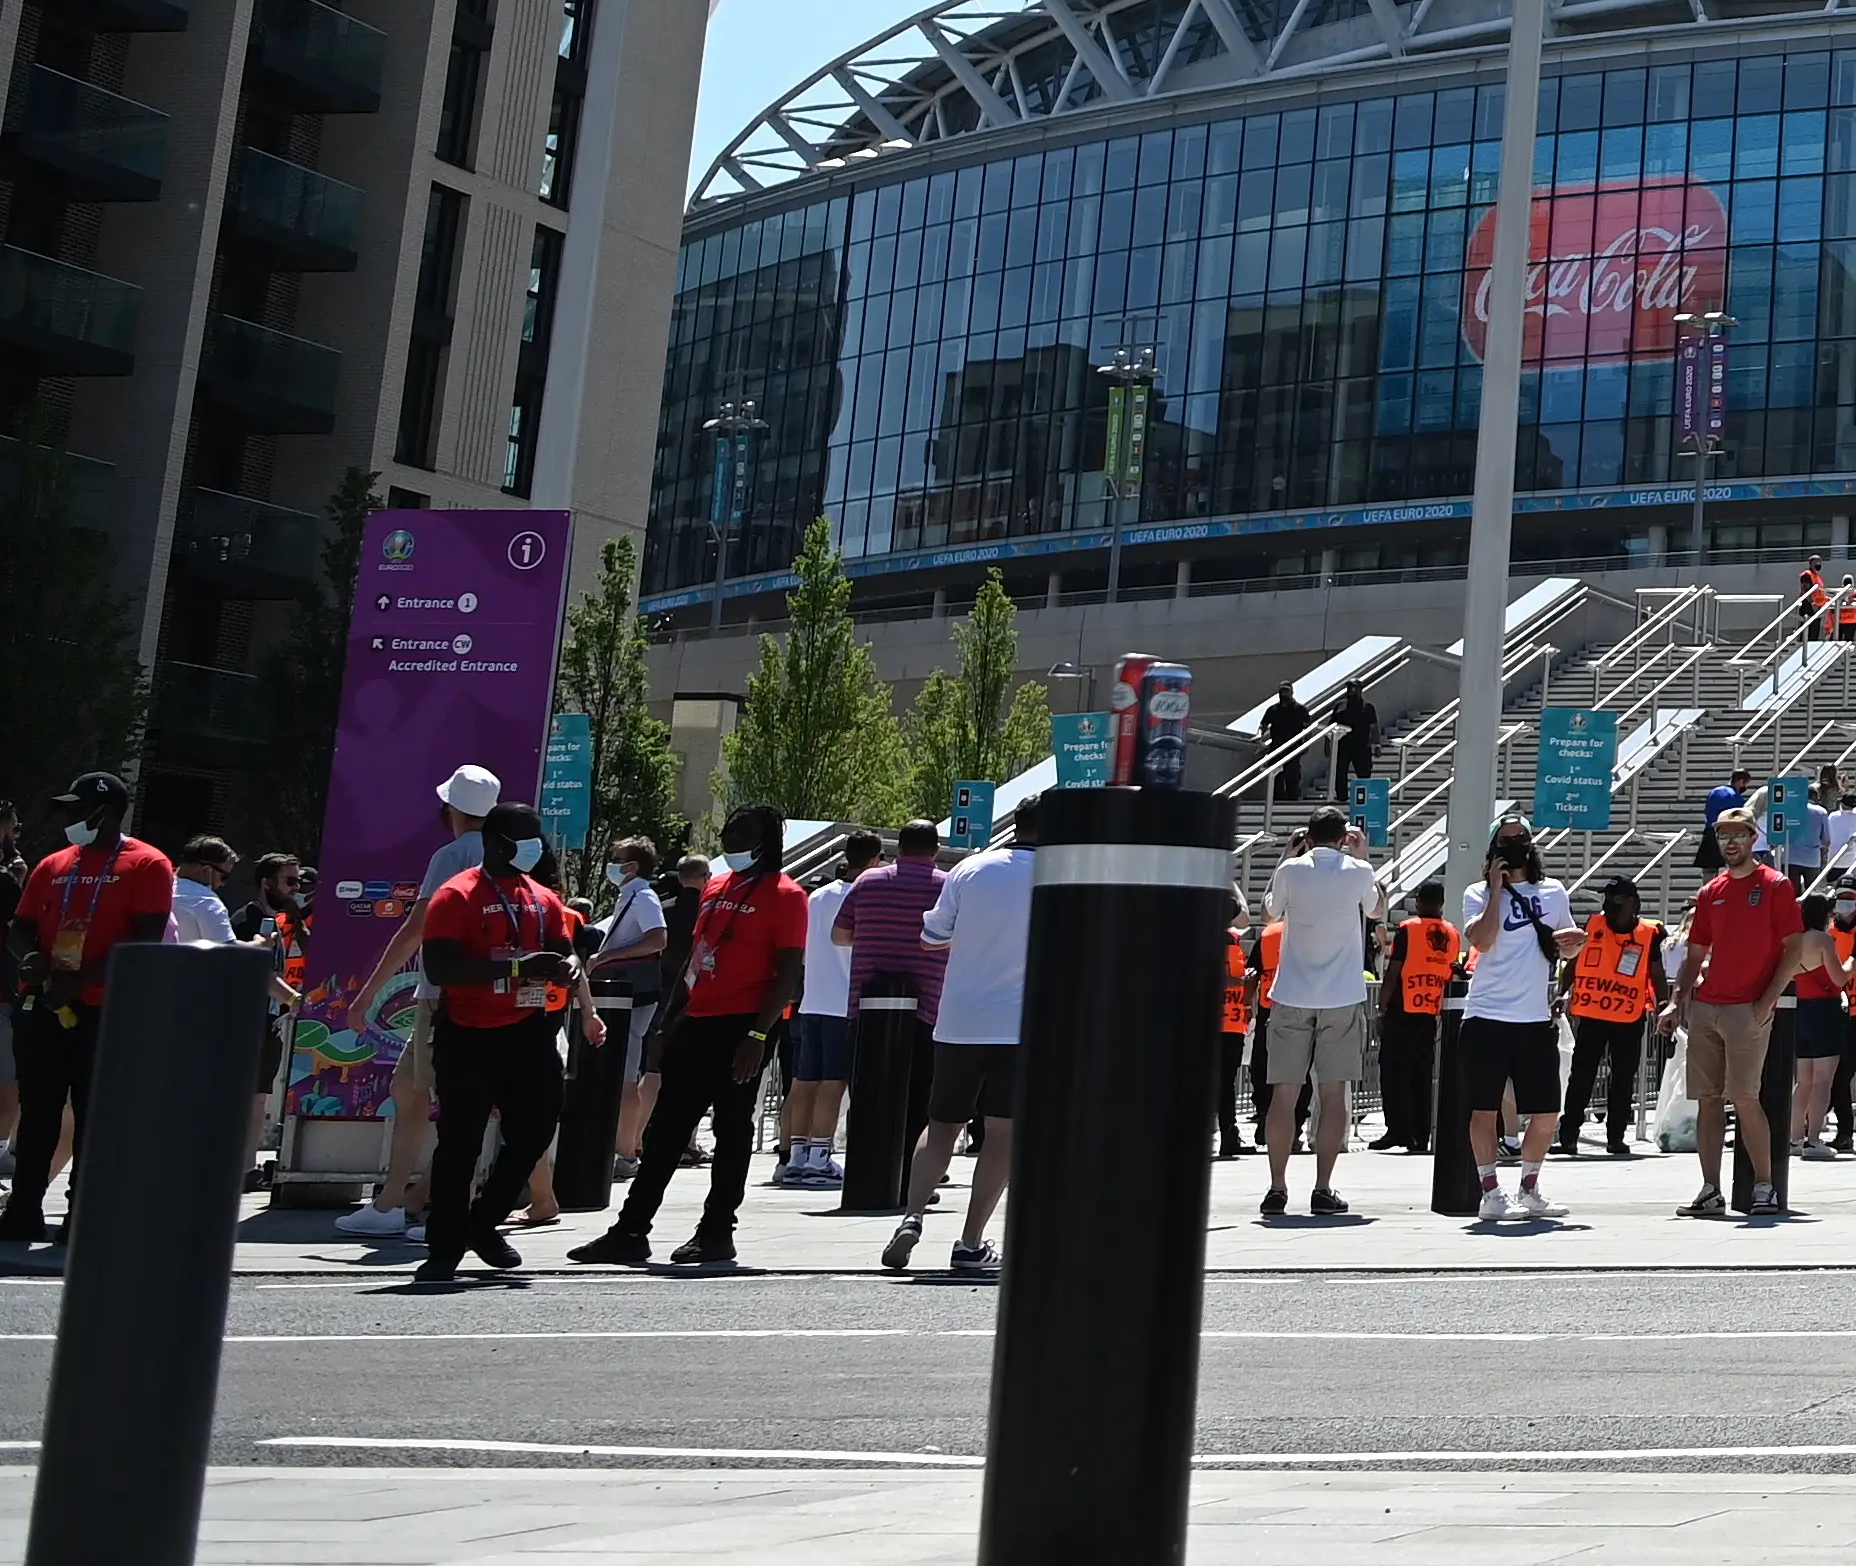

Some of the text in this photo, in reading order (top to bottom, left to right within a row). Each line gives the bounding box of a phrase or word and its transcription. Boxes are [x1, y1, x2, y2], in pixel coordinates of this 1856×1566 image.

[1630, 491, 1661, 504] UEFA
[1363, 504, 1454, 522] UEFA EURO 2020
[1130, 524, 1208, 543] UEFA EURO 2020
[397, 597, 454, 609] Entrance
[391, 639, 449, 650] Entrance
[389, 660, 518, 672] Accredited Entrance
[1063, 742, 1099, 752] Prepare
[1549, 737, 1604, 747] Prepare for
[547, 742, 581, 753] pare for
[546, 753, 573, 762] hecks:
[1558, 748, 1594, 758] checks:
[556, 781, 583, 789] status
[1064, 780, 1089, 788] Covid
[1544, 775, 1603, 786] Covid status
[542, 807, 571, 816] Tickets
[1555, 802, 1589, 812] Tickets
[80, 876, 94, 885] TO
[1575, 975, 1639, 1000] TEWARD
